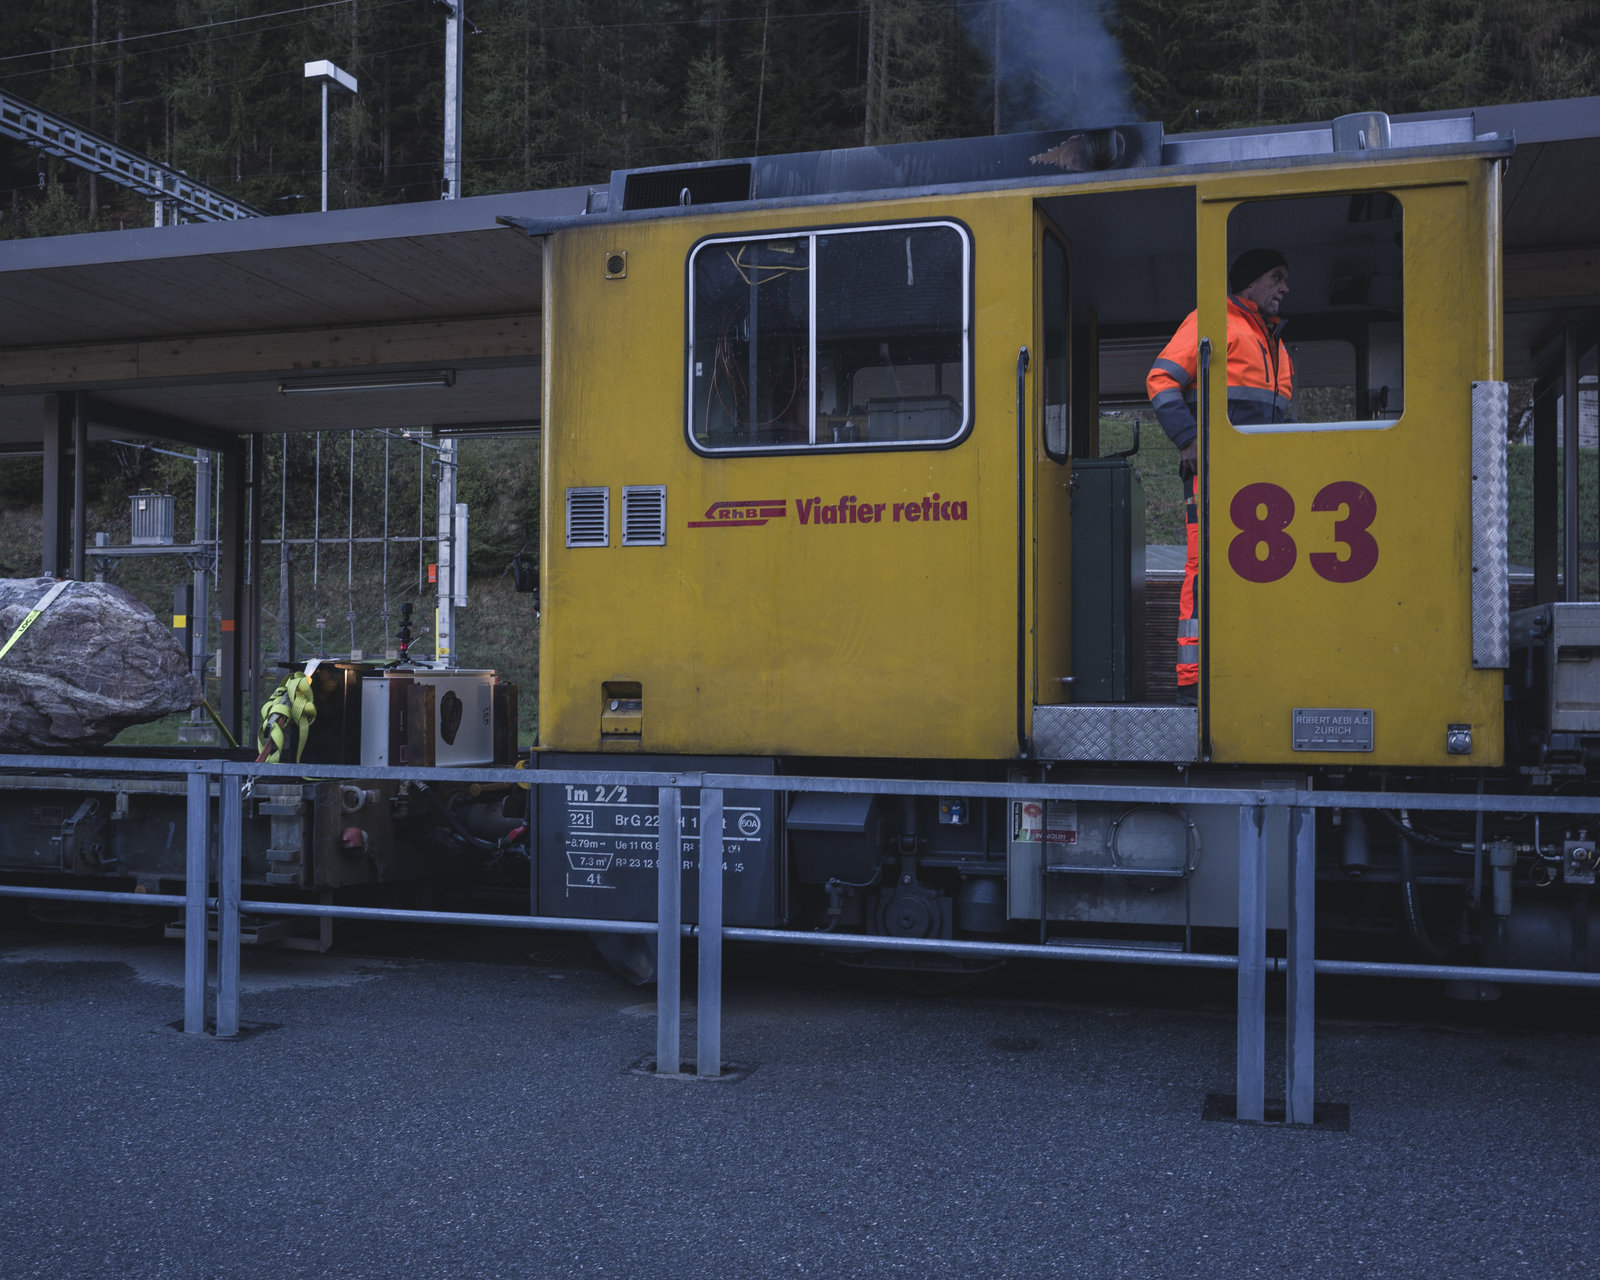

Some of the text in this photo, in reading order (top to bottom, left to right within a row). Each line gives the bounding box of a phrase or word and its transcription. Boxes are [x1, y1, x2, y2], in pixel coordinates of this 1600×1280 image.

[719, 493, 968, 525] RhB Viafier retica
[1228, 481, 1379, 582] 83
[1296, 716, 1330, 724] ROBERT
[1331, 716, 1352, 725] AEBI
[565, 785, 628, 803] Tm 2/2
[615, 840, 628, 850] Ue
[640, 841, 653, 851] 03
[580, 857, 594, 866] 7.3
[629, 858, 641, 868] 23
[643, 859, 654, 868] 12
